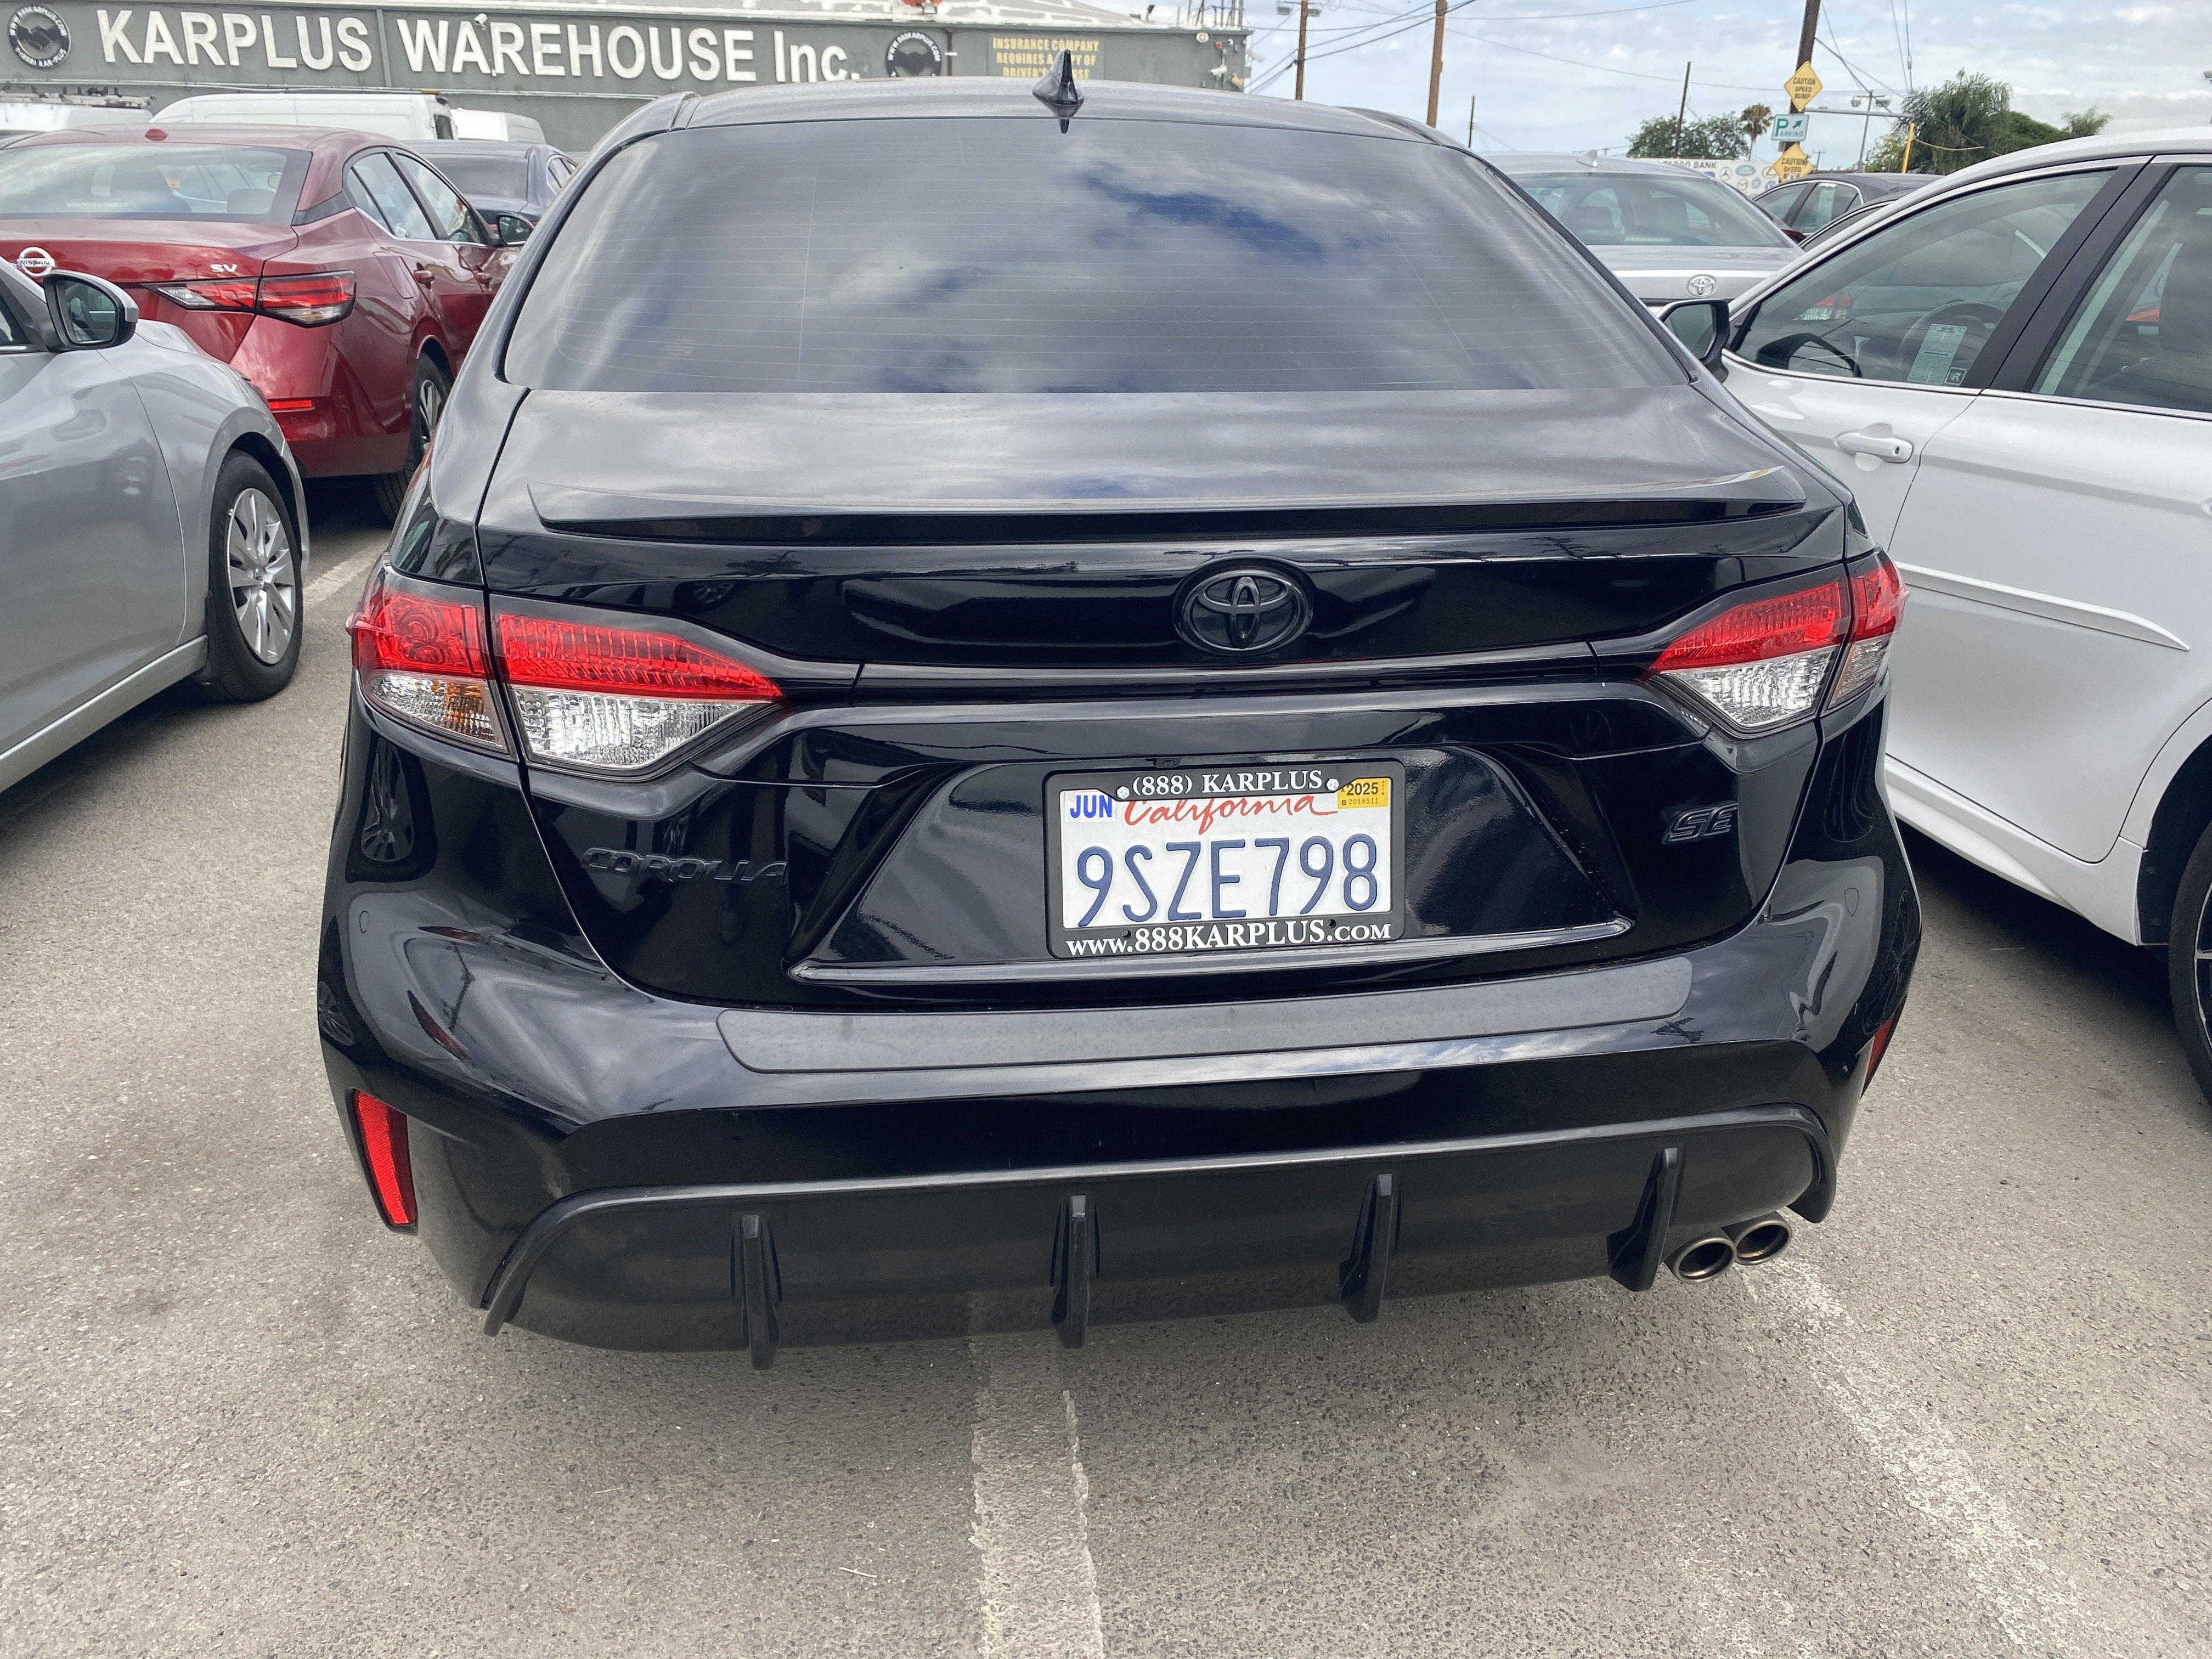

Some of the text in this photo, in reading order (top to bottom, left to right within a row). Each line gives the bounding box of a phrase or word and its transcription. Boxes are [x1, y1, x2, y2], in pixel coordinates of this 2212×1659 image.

[97, 9, 860, 83] KARPLUS WAREHOUSE Inc.
[992, 37, 1099, 52] INSURANCE COMPANY
[996, 52, 1045, 65] REQUIRES
[1084, 55, 1097, 66] OF
[210, 263, 238, 273] SV
[1133, 769, 1322, 796] (888) KARPLUS
[1346, 782, 1379, 796] 2025
[1070, 794, 1113, 819] JUN
[1348, 797, 1379, 805] 2018511
[1124, 795, 1339, 835] California
[1662, 800, 1739, 845] SE
[580, 846, 789, 884] COROLLA
[1076, 833, 1378, 928] 9SZE798
